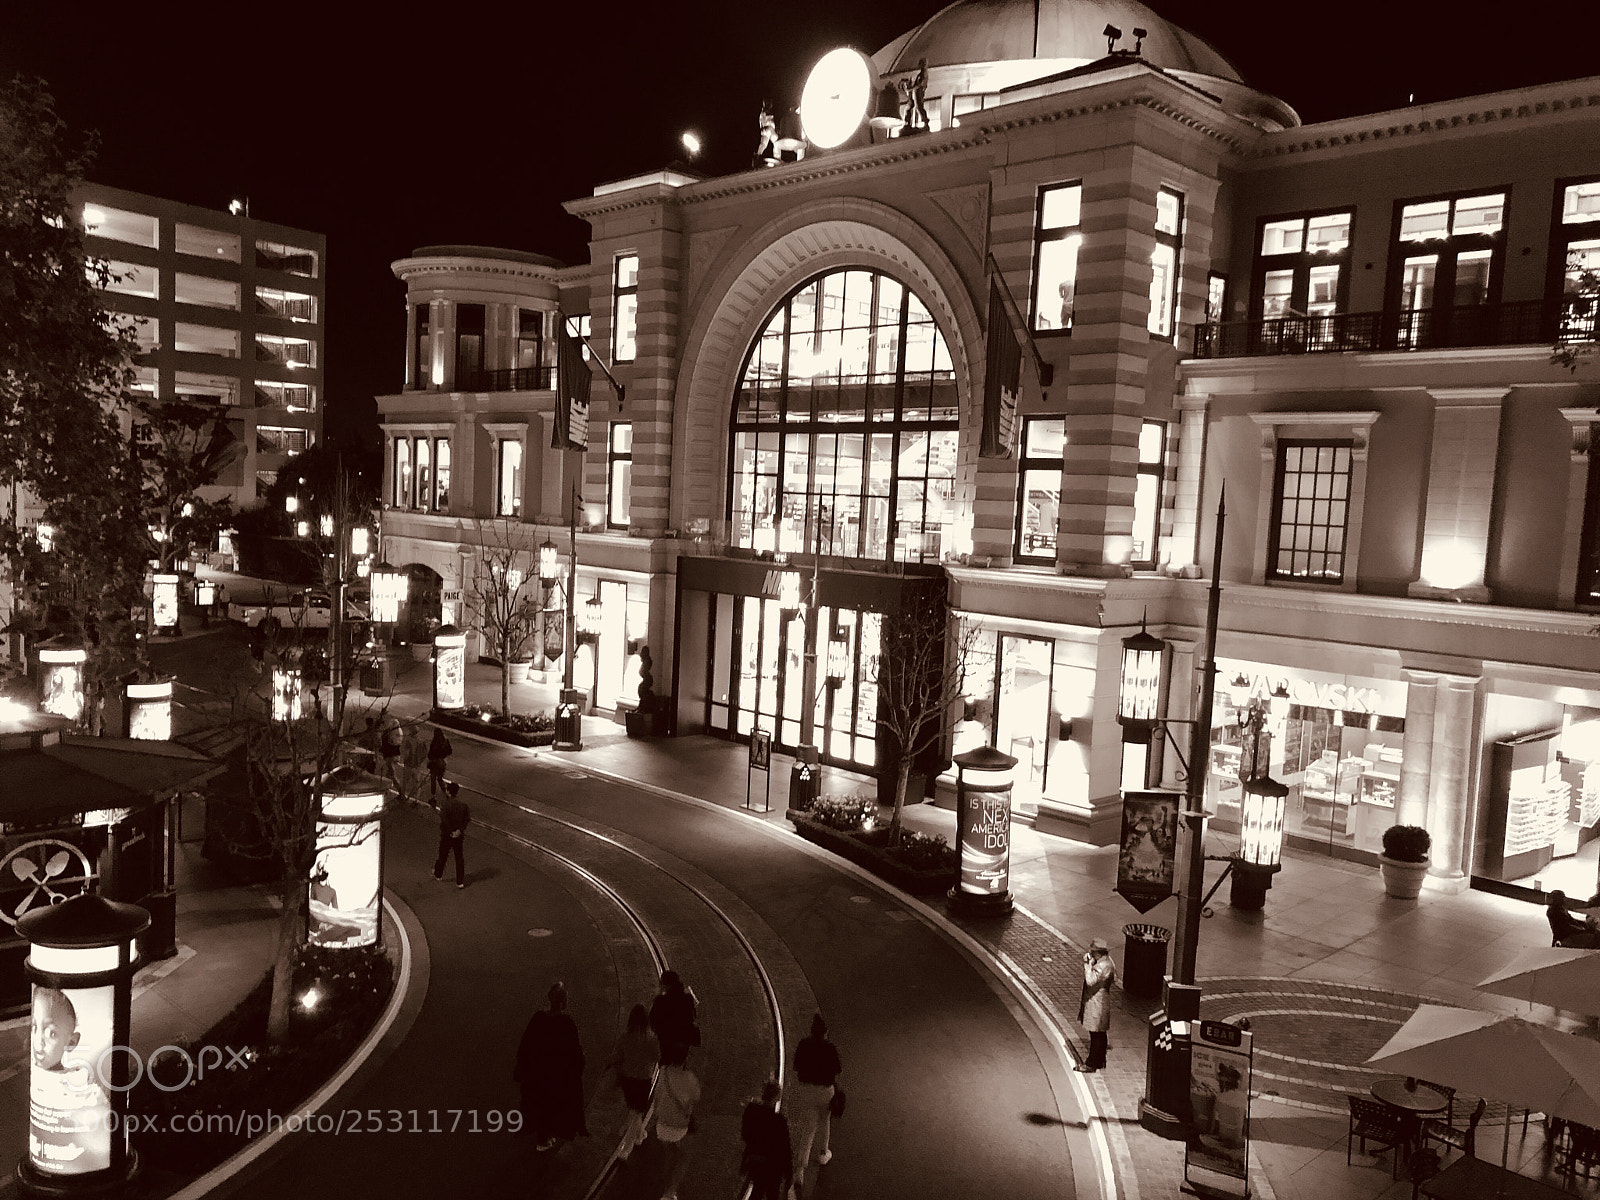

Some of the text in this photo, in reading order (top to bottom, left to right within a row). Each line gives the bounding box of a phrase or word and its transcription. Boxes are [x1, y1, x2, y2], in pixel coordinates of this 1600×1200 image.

[569, 397, 589, 447] NIKE
[444, 591, 460, 600] PAIGE
[970, 799, 979, 809] IS
[981, 800, 1003, 810] THIS
[984, 834, 1008, 848] IDOL
[1206, 1026, 1235, 1041] EBAR
